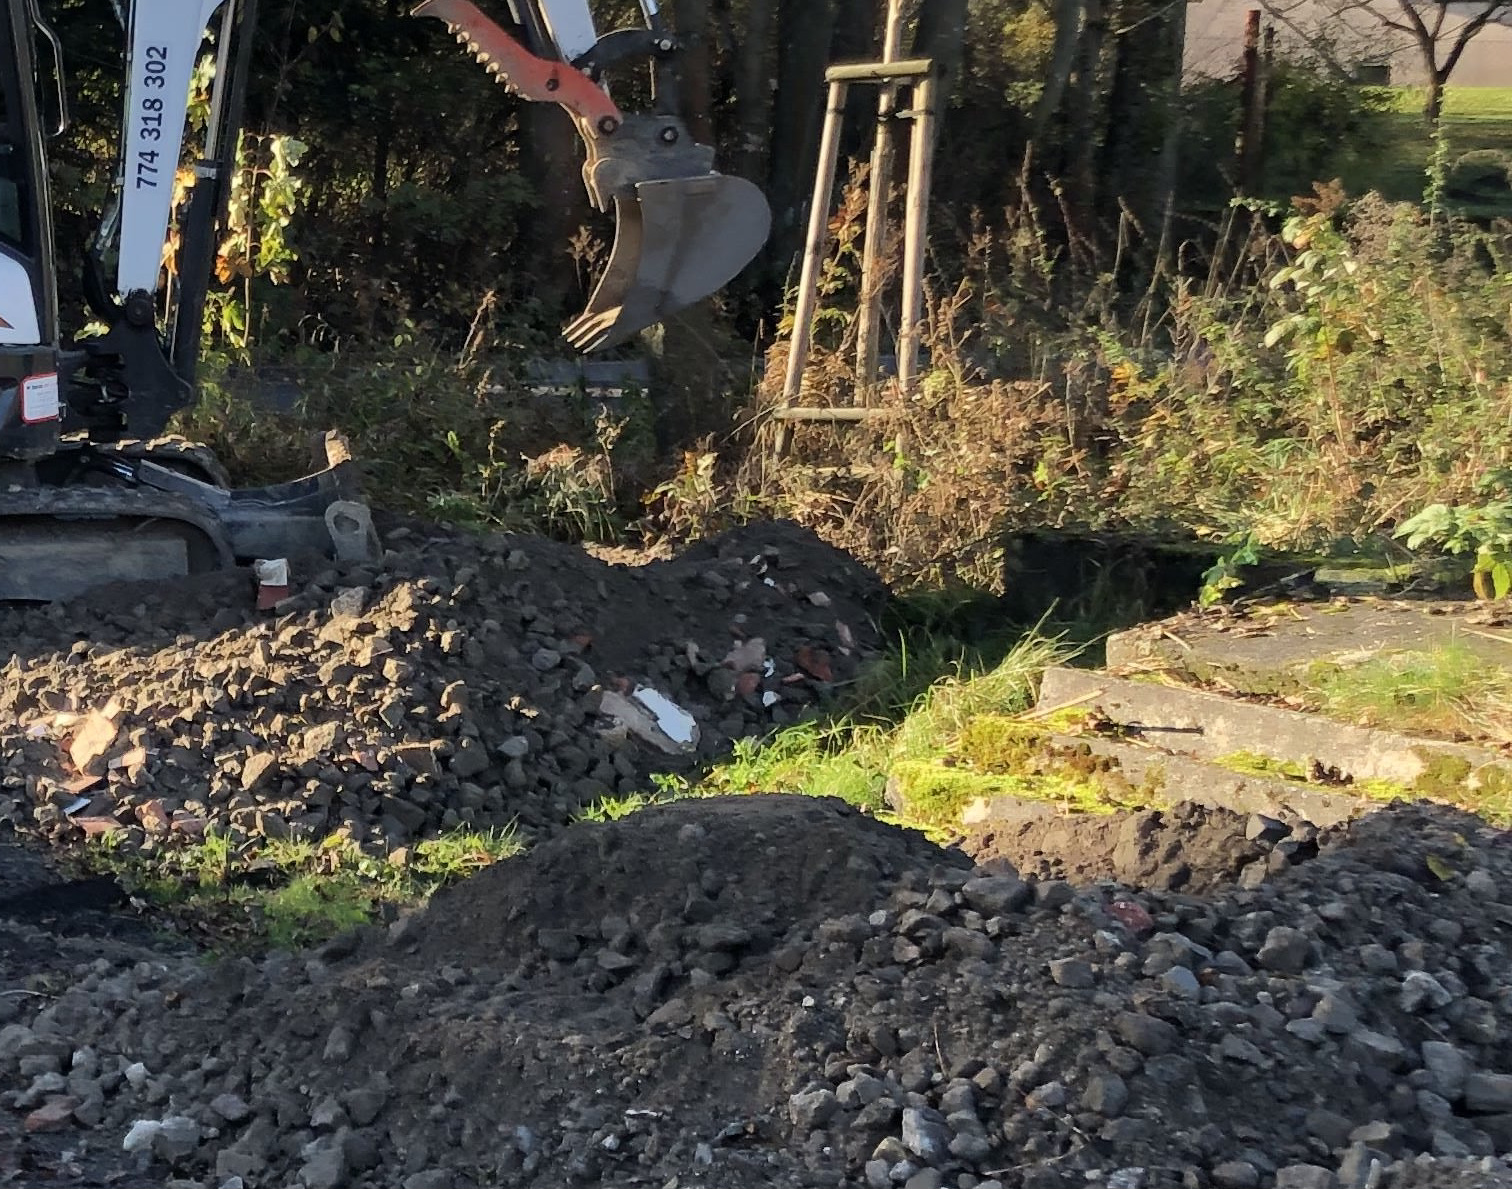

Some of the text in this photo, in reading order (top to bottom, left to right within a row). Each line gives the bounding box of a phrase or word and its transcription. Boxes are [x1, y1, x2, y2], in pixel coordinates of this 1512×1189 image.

[136, 46, 168, 189] 774 318 302
